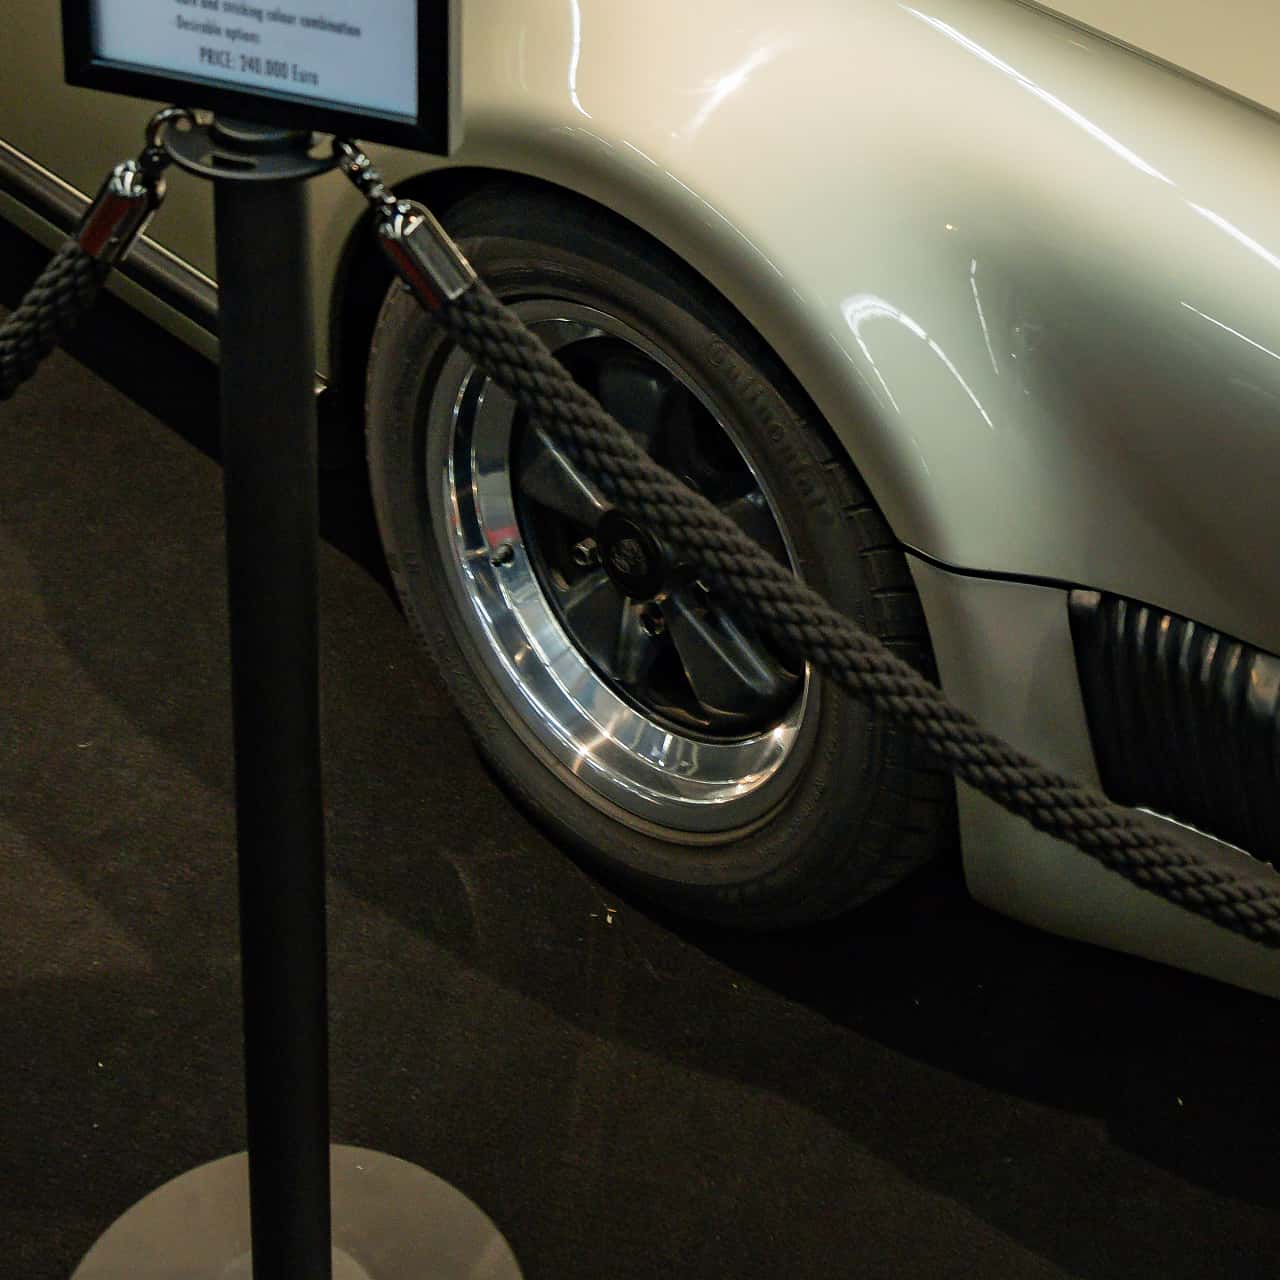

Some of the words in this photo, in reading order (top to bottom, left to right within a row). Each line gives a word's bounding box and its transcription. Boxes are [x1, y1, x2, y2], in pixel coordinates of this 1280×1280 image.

[299, 15, 361, 37] combination
[199, 47, 234, 69] PRICE:
[292, 62, 319, 86] Euro
